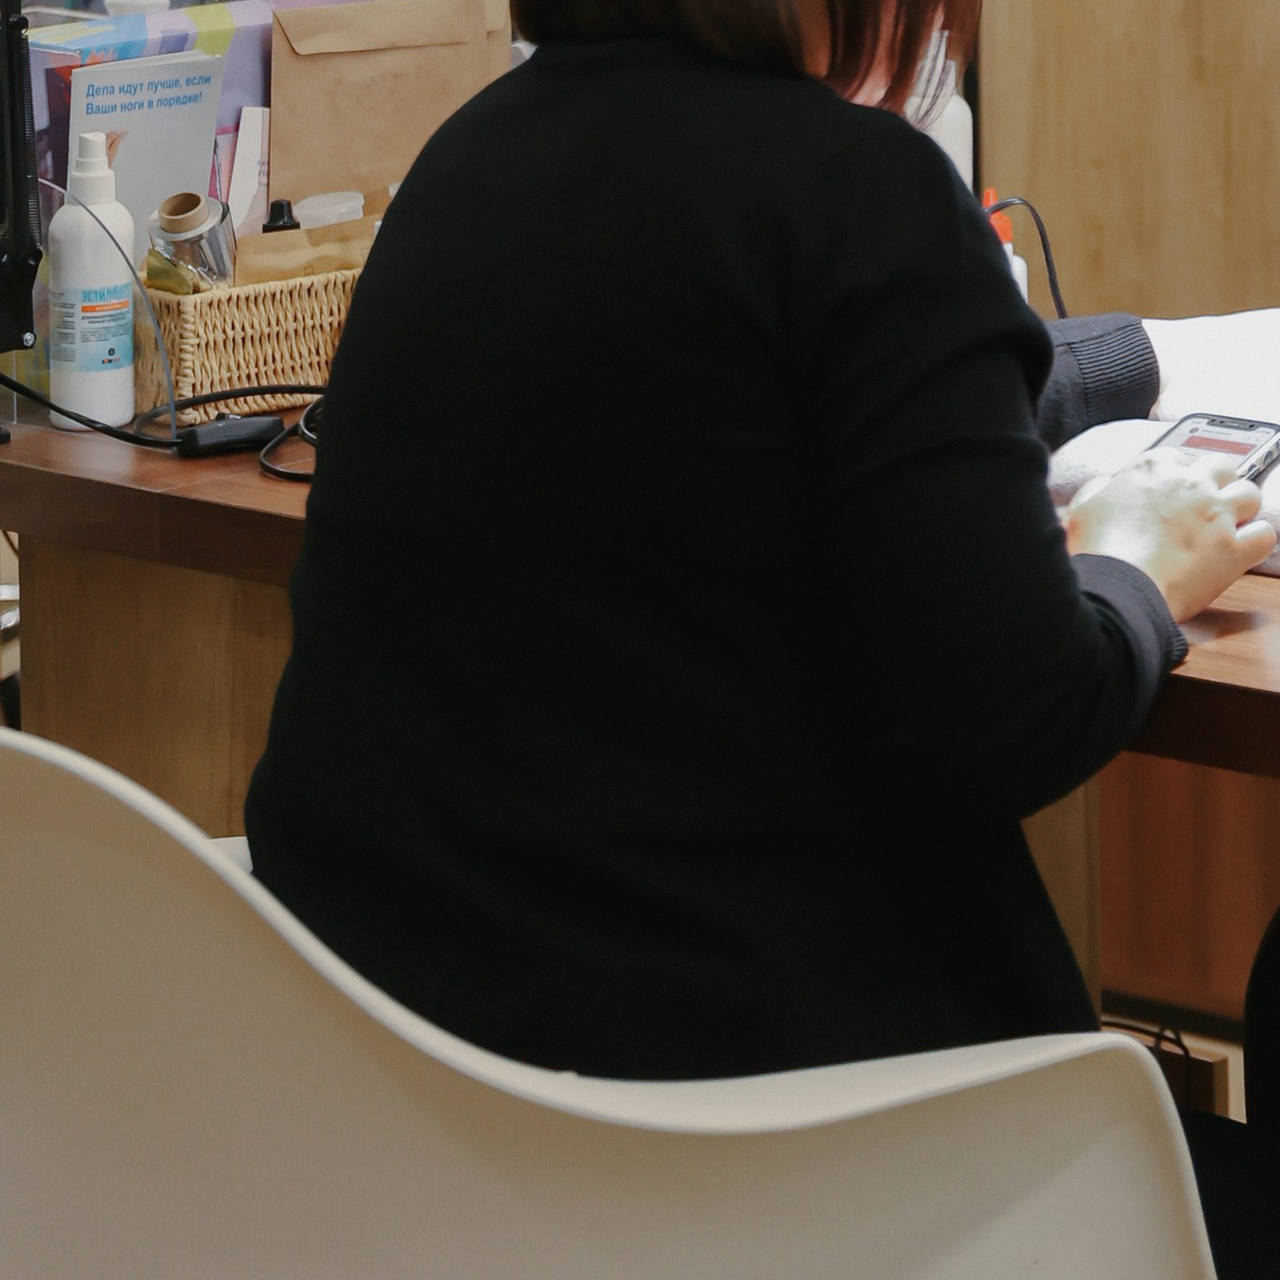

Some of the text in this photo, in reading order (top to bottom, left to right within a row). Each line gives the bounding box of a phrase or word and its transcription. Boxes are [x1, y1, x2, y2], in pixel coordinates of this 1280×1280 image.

[86, 75, 211, 99] Дела идут лучше, если
[85, 91, 203, 115] Ваши ноги в порядке!
